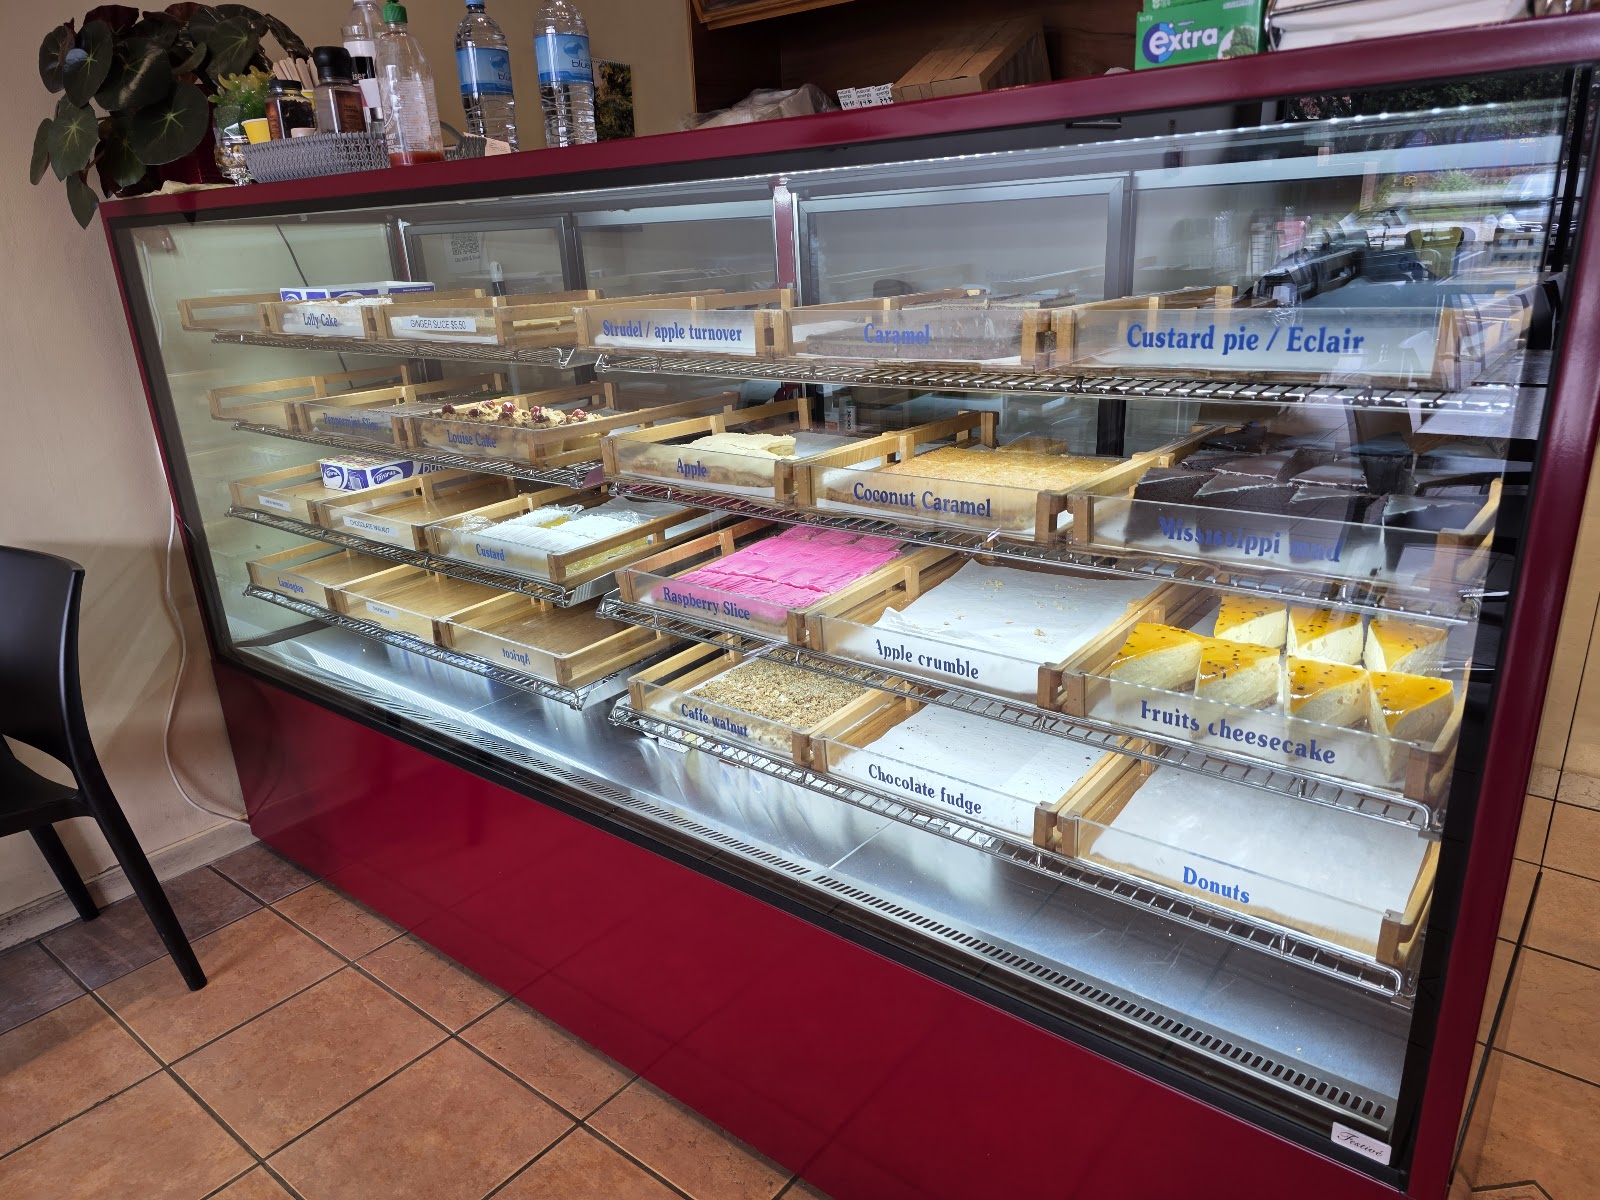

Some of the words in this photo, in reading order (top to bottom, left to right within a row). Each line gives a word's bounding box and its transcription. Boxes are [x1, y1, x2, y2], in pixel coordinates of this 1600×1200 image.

[1149, 27, 1218, 55] extra
[303, 313, 319, 328] Lolly
[321, 315, 338, 327] Cake
[410, 319, 432, 328] GINGER
[433, 320, 450, 329] SLICE
[450, 320, 466, 329] $5.50
[602, 319, 643, 340] Strudel
[645, 320, 651, 338] /
[654, 321, 686, 343] apple
[689, 323, 742, 342] turnover
[863, 323, 931, 345] Caramel
[1127, 324, 1215, 350] Custard
[1222, 325, 1259, 356] pie
[1266, 327, 1280, 352] /
[1286, 326, 1365, 355] Eclair
[323, 412, 360, 429] Peppermint
[362, 417, 379, 431] Slice
[447, 429, 473, 446] Louise
[474, 432, 497, 448] Cake
[676, 457, 708, 478] Apple
[853, 482, 916, 508] Coconut
[922, 491, 992, 517] Caramel
[349, 519, 373, 530] CHOCOLATE
[476, 543, 506, 562] Custard
[1158, 516, 1281, 556] Mississippi
[1289, 538, 1343, 562] mud
[663, 586, 719, 616] Raspberry
[723, 600, 750, 621] Slice
[876, 638, 913, 662] Apple
[918, 654, 979, 679] crumble
[681, 703, 709, 725] Caffe
[712, 714, 748, 737] walnut
[1141, 699, 1200, 732] Fruits
[1208, 718, 1336, 764] cheesecake
[868, 763, 935, 798] Chocolate
[940, 787, 982, 815] fudge
[1182, 865, 1250, 903] Donuts
